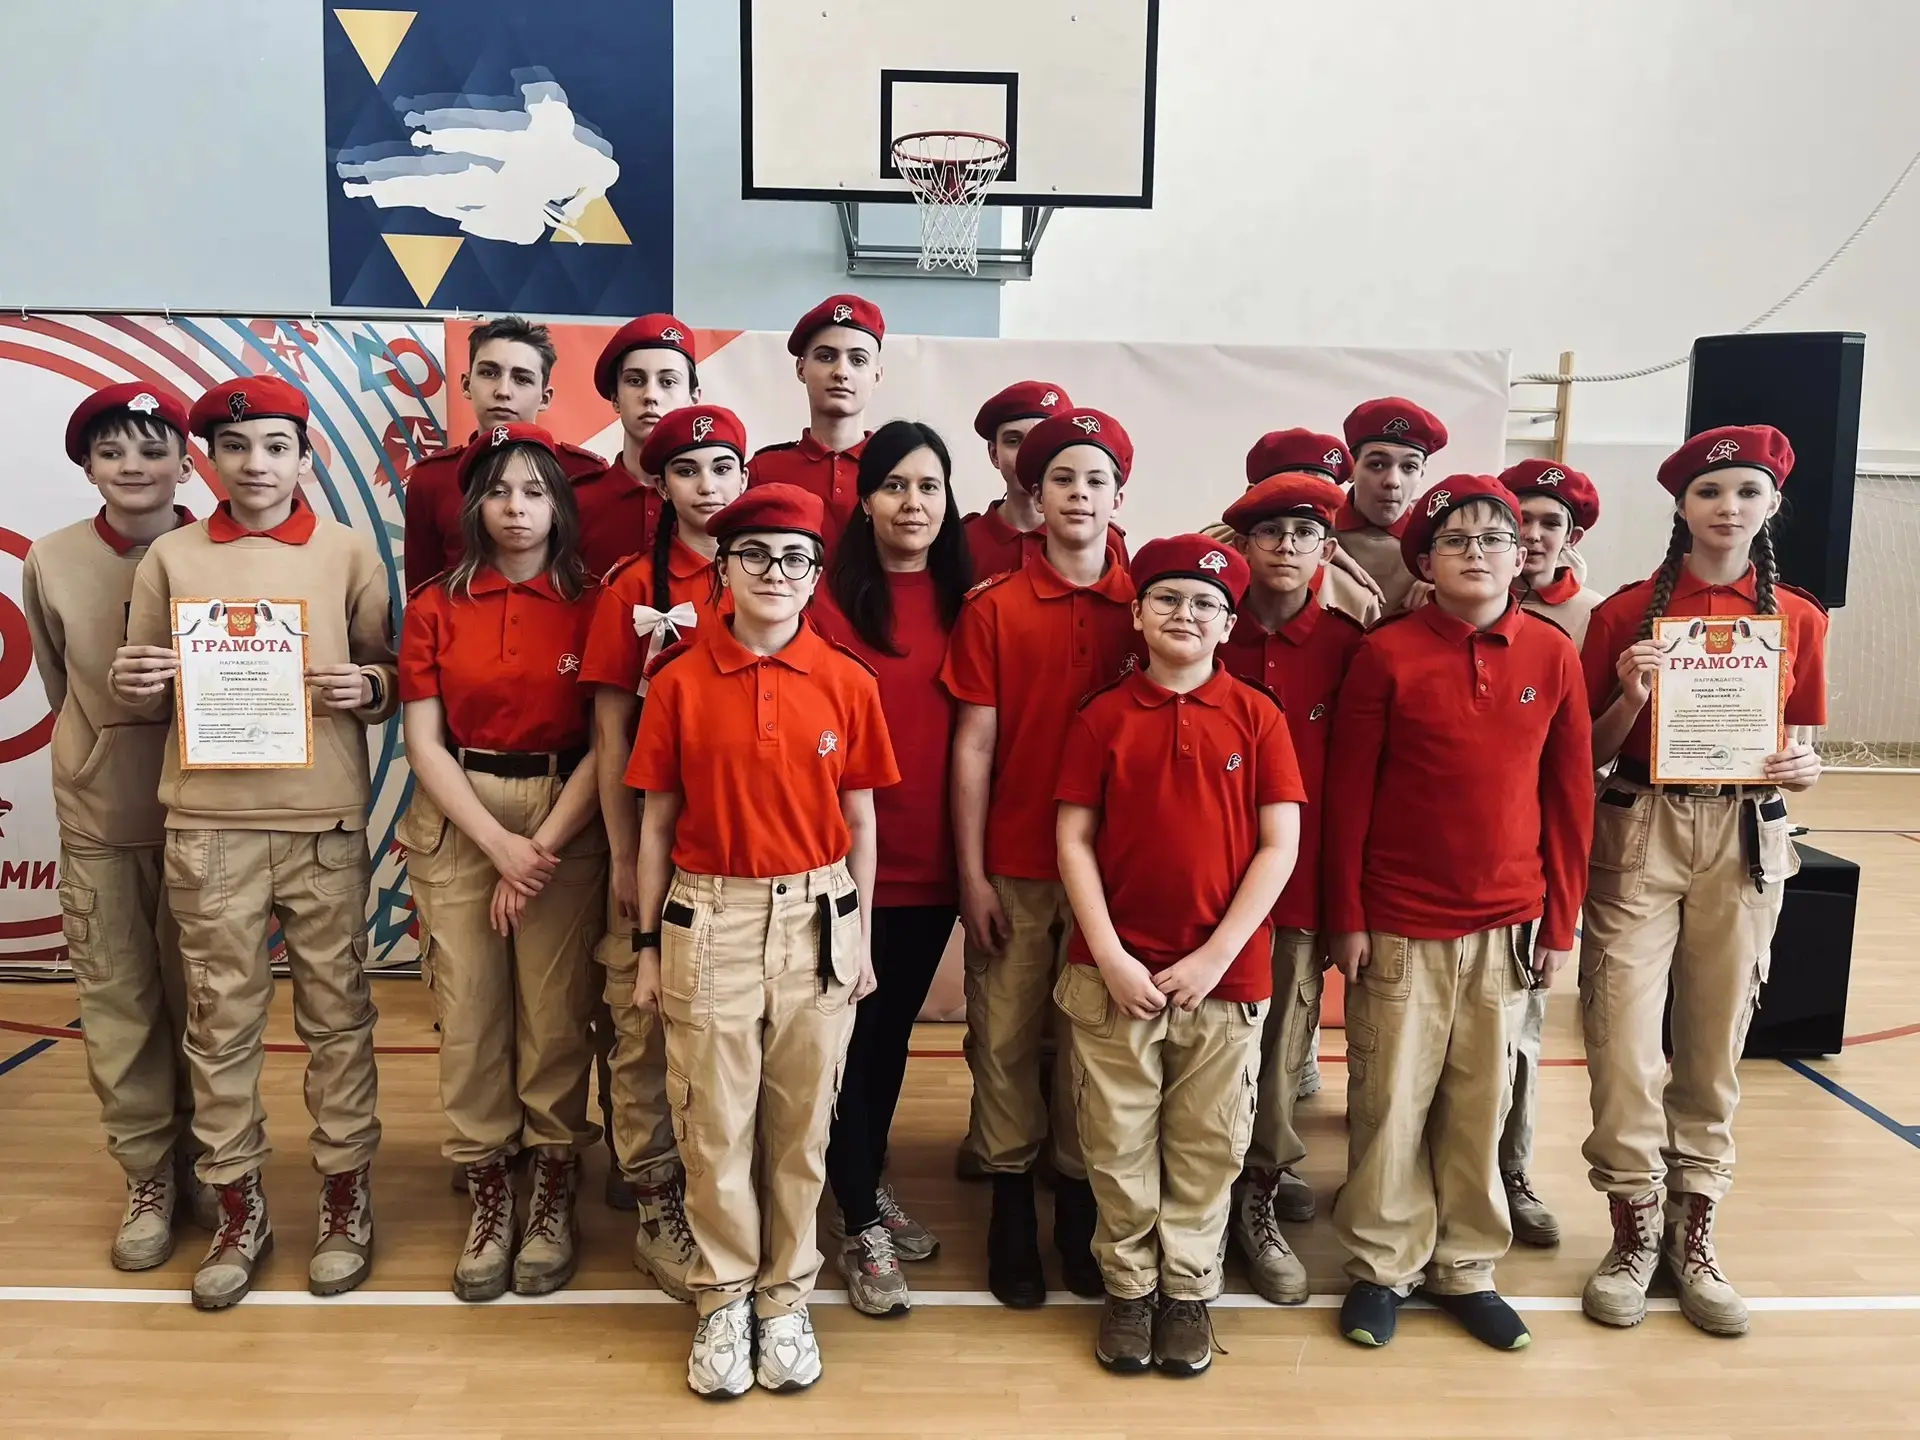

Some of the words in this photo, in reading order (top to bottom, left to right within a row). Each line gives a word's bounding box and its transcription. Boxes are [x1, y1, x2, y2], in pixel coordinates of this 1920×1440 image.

[191, 639, 293, 653] ГРАМОТА
[1669, 656, 1768, 670] ГРАМОТА
[0, 860, 61, 890] МИ
